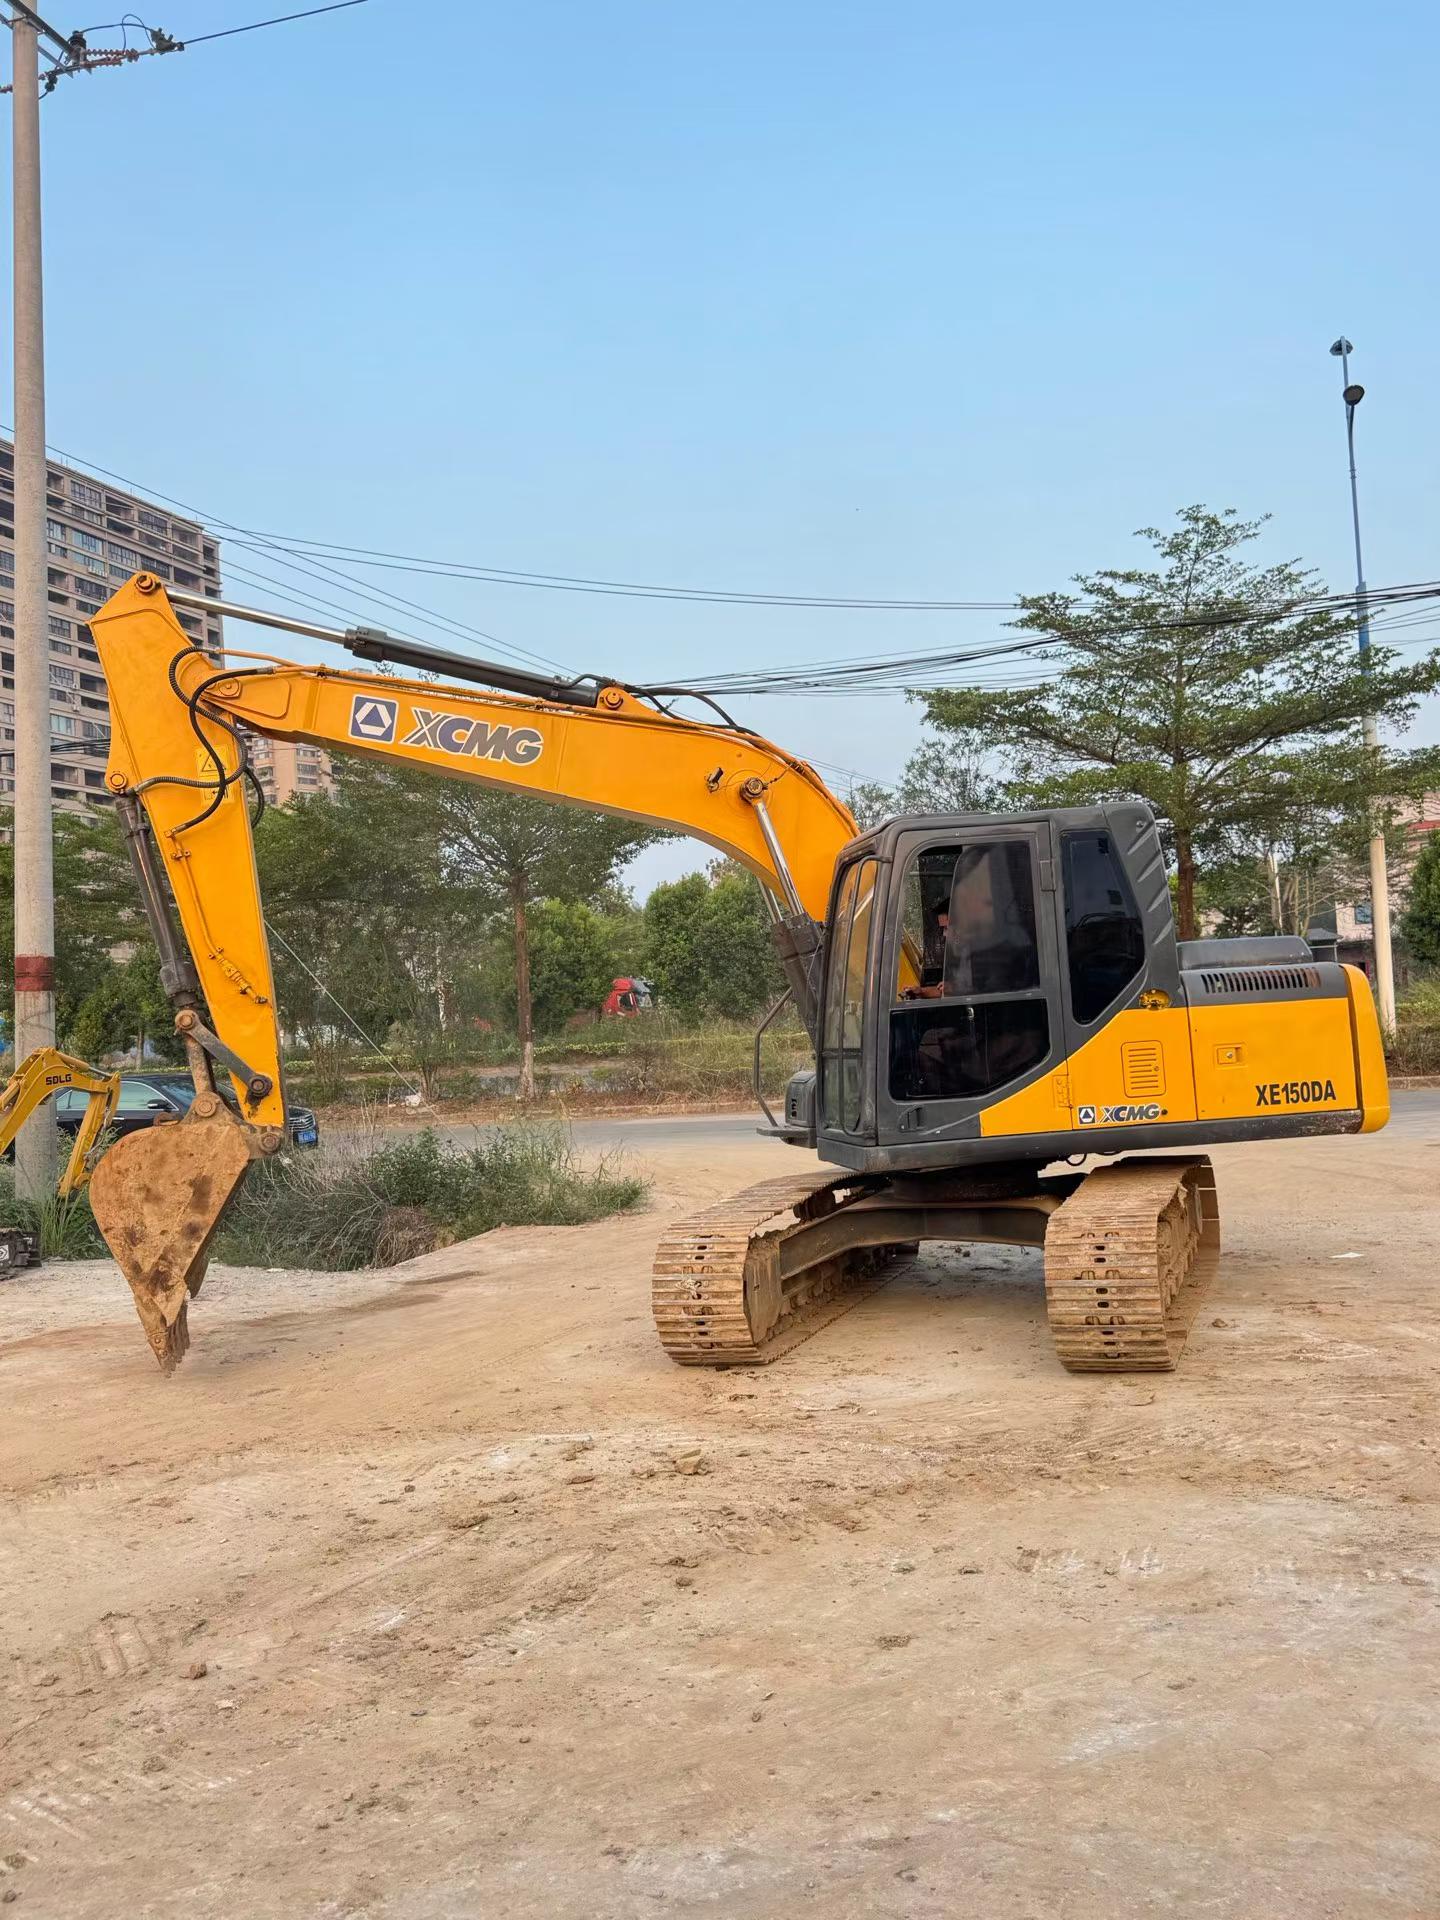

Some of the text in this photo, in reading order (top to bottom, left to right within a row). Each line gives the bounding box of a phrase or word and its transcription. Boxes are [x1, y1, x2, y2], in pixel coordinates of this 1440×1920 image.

[402, 708, 544, 766] XCMG
[45, 1074, 72, 1086] SDLG
[1255, 1079, 1337, 1107] XE150DA
[1100, 1103, 1160, 1124] XCMG
